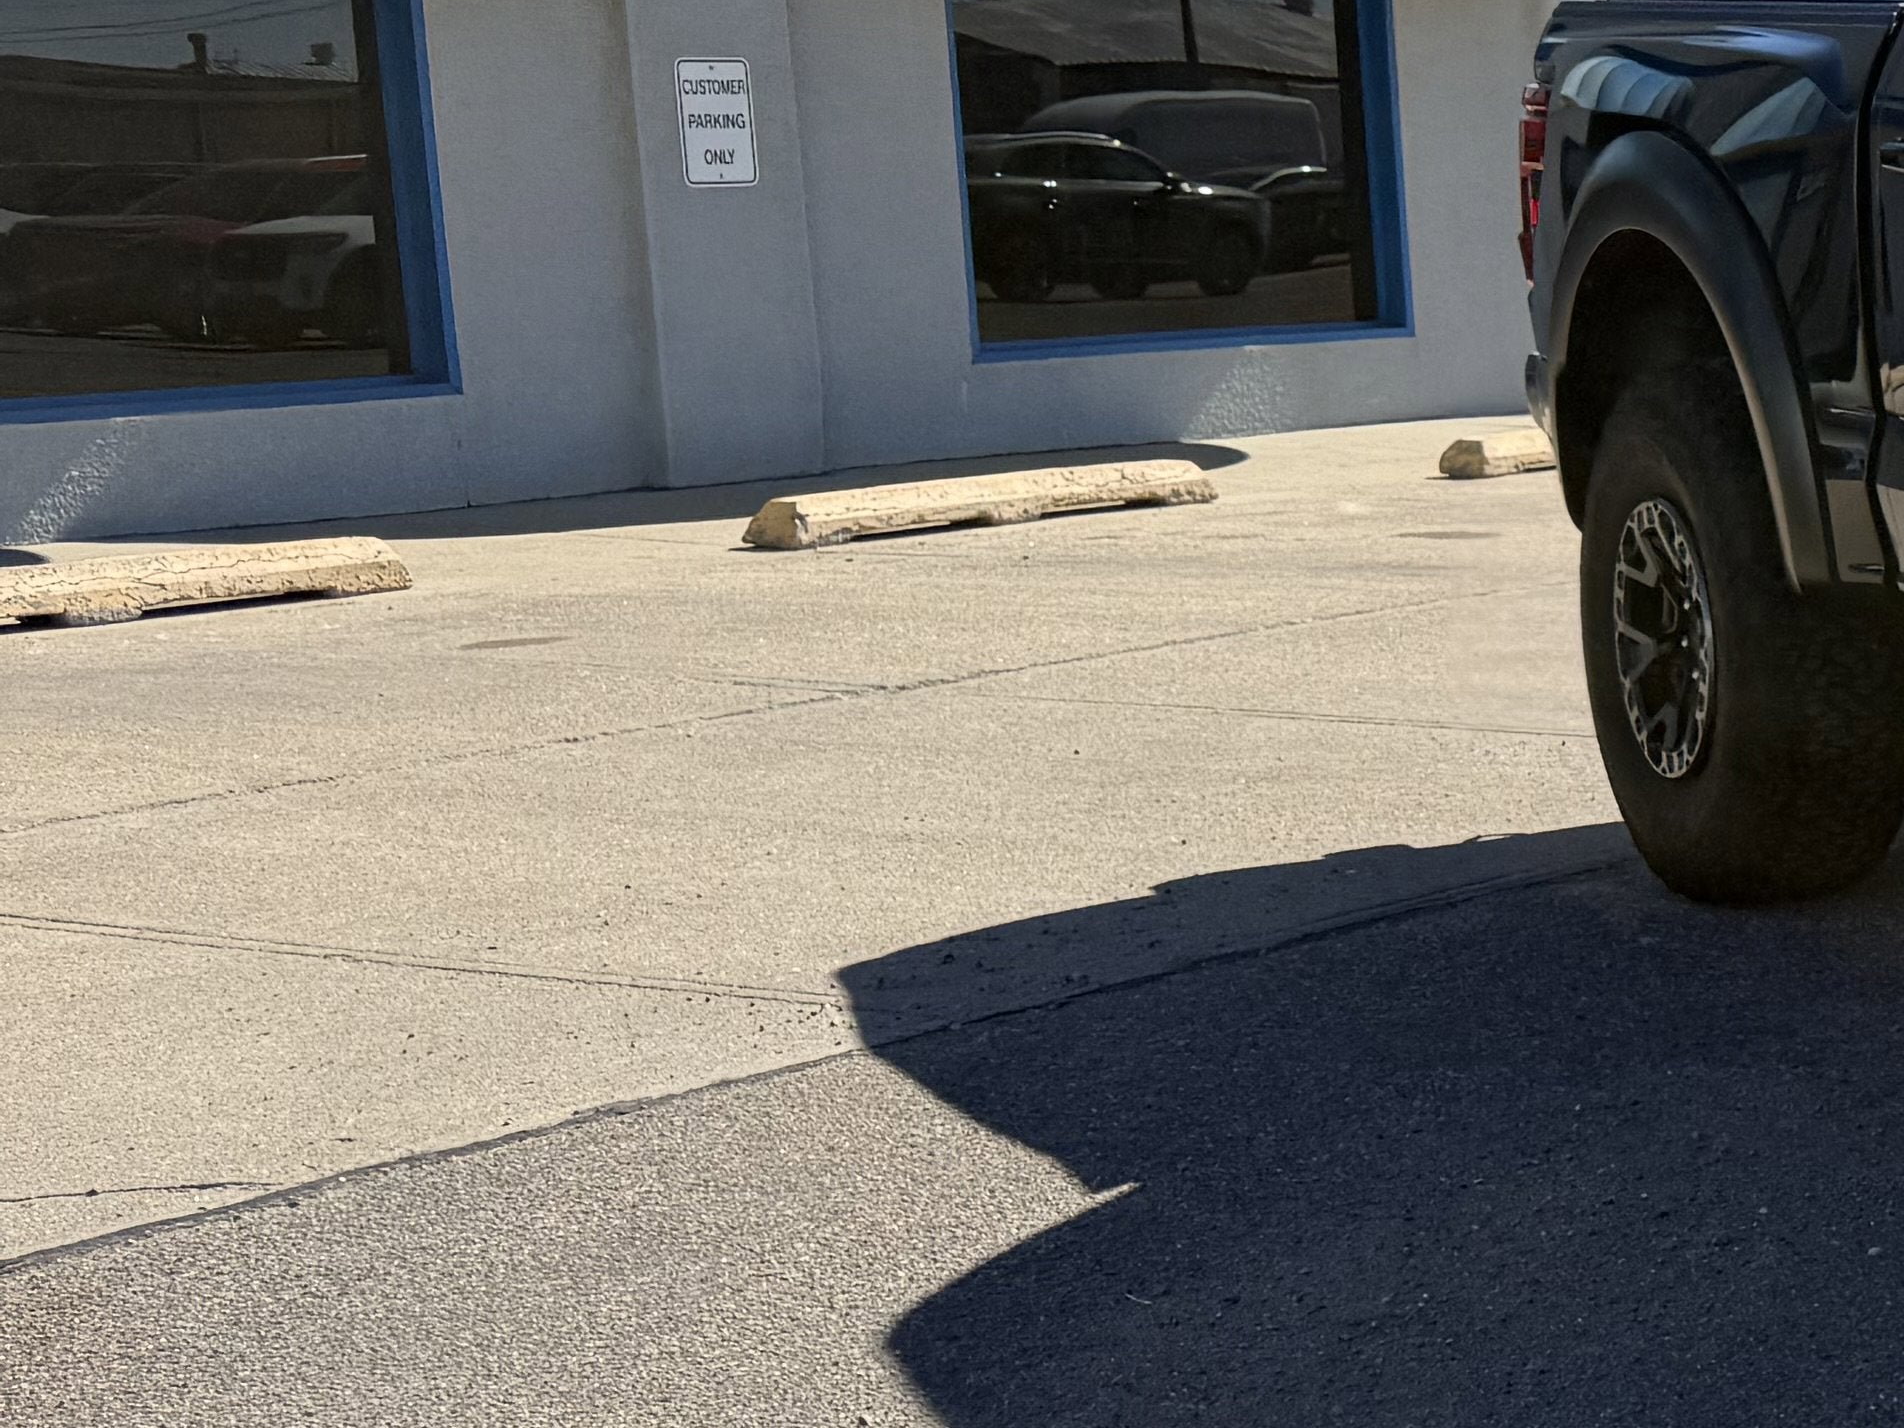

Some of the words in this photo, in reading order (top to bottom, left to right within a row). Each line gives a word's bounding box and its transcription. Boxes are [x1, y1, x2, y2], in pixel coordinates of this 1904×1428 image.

[682, 79, 745, 95] CUSTOMER
[688, 113, 746, 129] PARKING
[704, 149, 735, 165] ONLY
